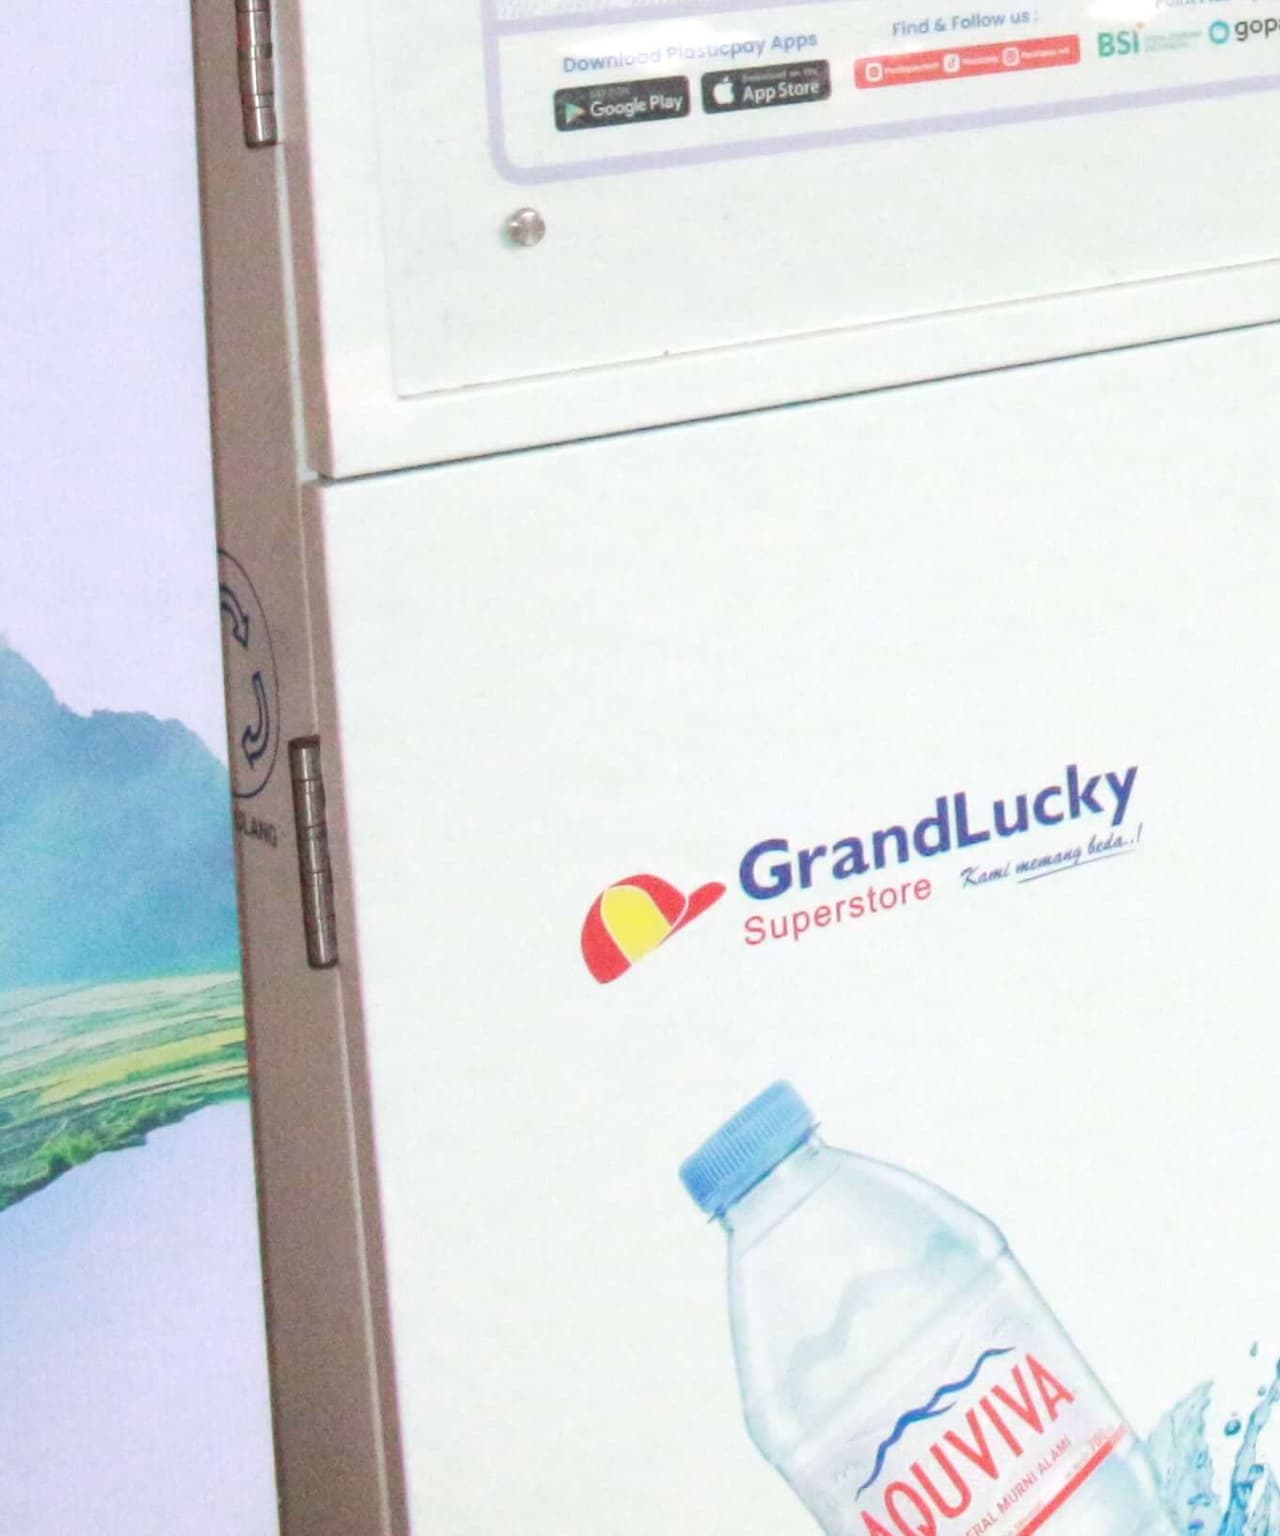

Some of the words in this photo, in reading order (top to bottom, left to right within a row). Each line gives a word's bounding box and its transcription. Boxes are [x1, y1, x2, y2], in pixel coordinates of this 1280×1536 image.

[892, 19, 930, 37] Find
[934, 18, 946, 33] &
[951, 12, 1006, 31] Follow
[563, 48, 661, 74] Download
[771, 32, 818, 52] Apps
[589, 98, 647, 119] Google
[650, 92, 683, 113] Play
[741, 85, 774, 103] App
[778, 80, 821, 98] Store
[739, 764, 1138, 901] GrandLucky
[961, 861, 1011, 889] Kami
[1016, 846, 1083, 875] memang
[744, 878, 932, 946] Superstore
[996, 1472, 1038, 1513] MURNI
[1038, 1436, 1072, 1476] ALAMI
